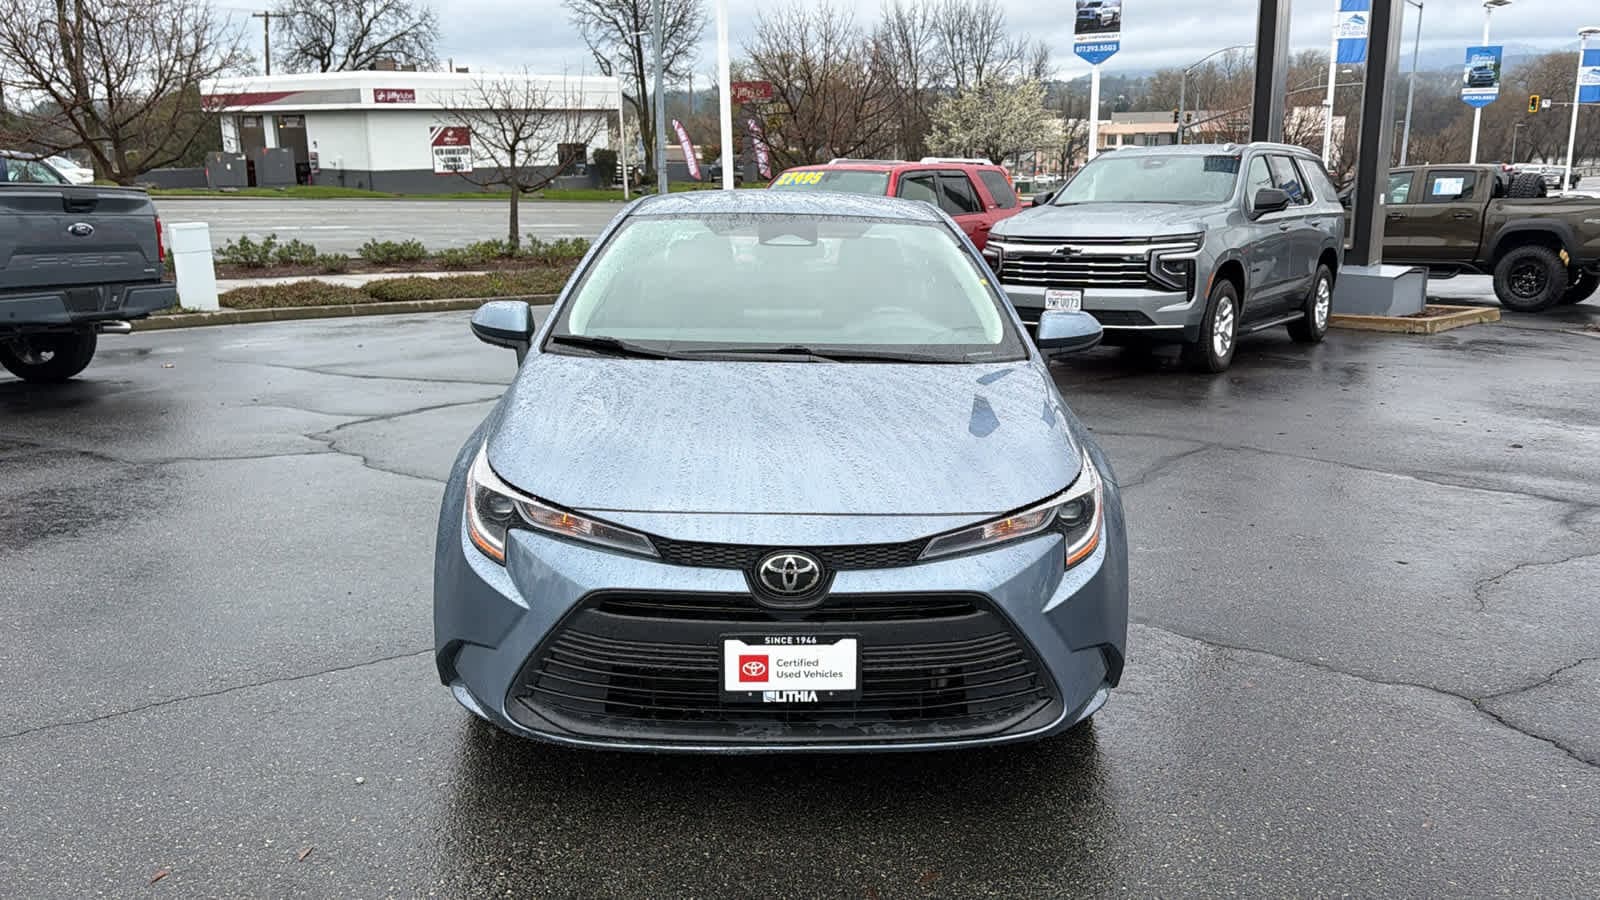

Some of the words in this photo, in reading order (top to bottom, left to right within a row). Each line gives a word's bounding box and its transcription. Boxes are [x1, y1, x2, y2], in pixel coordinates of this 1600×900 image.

[764, 636, 793, 645] SINCE
[796, 636, 817, 644] 1946
[776, 658, 820, 668] Certified
[776, 670, 801, 679] Used
[803, 669, 844, 679] Vehicles
[775, 690, 818, 703] LITHIA
